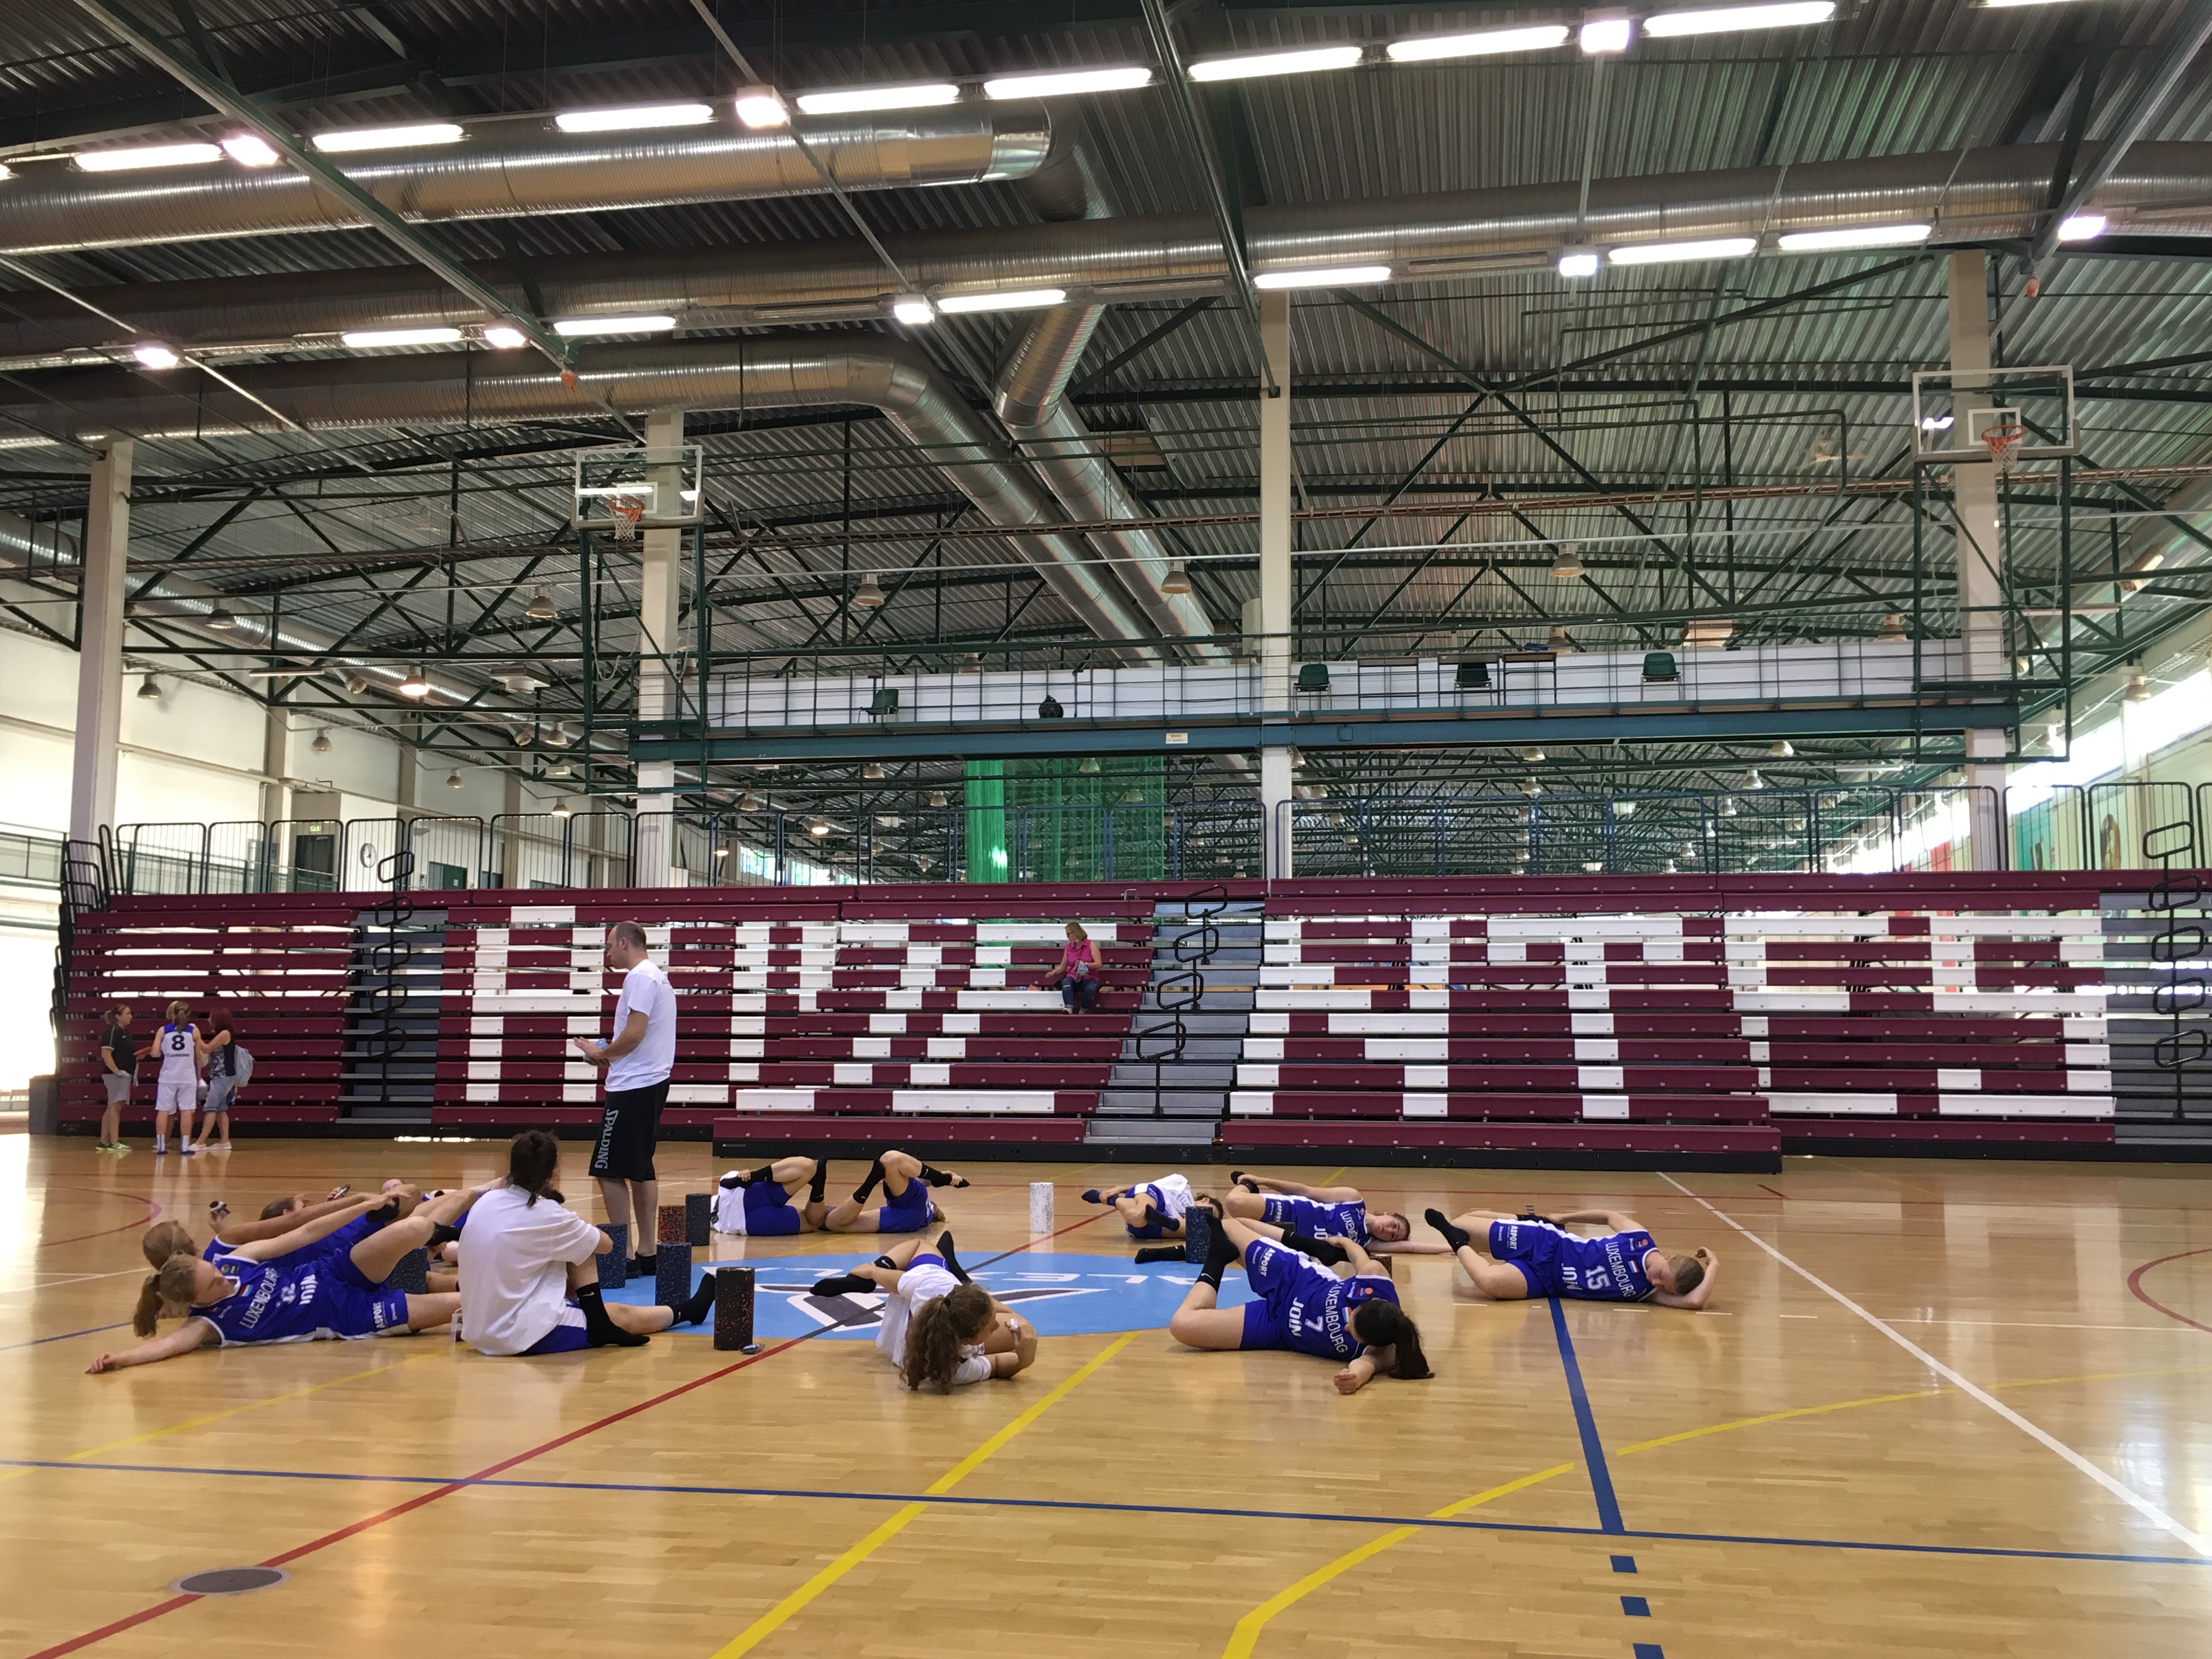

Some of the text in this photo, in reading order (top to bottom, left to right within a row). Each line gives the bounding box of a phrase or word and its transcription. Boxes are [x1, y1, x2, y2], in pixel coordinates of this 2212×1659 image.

[171, 1034, 185, 1051] 8
[594, 1109, 619, 1169] SPALDING
[1509, 1225, 1519, 1250] ASPORT
[1260, 1248, 1276, 1277] ASPORT
[1605, 1242, 1637, 1297] LUXEMBOURG
[1584, 1265, 1611, 1290] 15
[373, 1301, 386, 1328] ASPORT
[1305, 1316, 1323, 1332] 7
